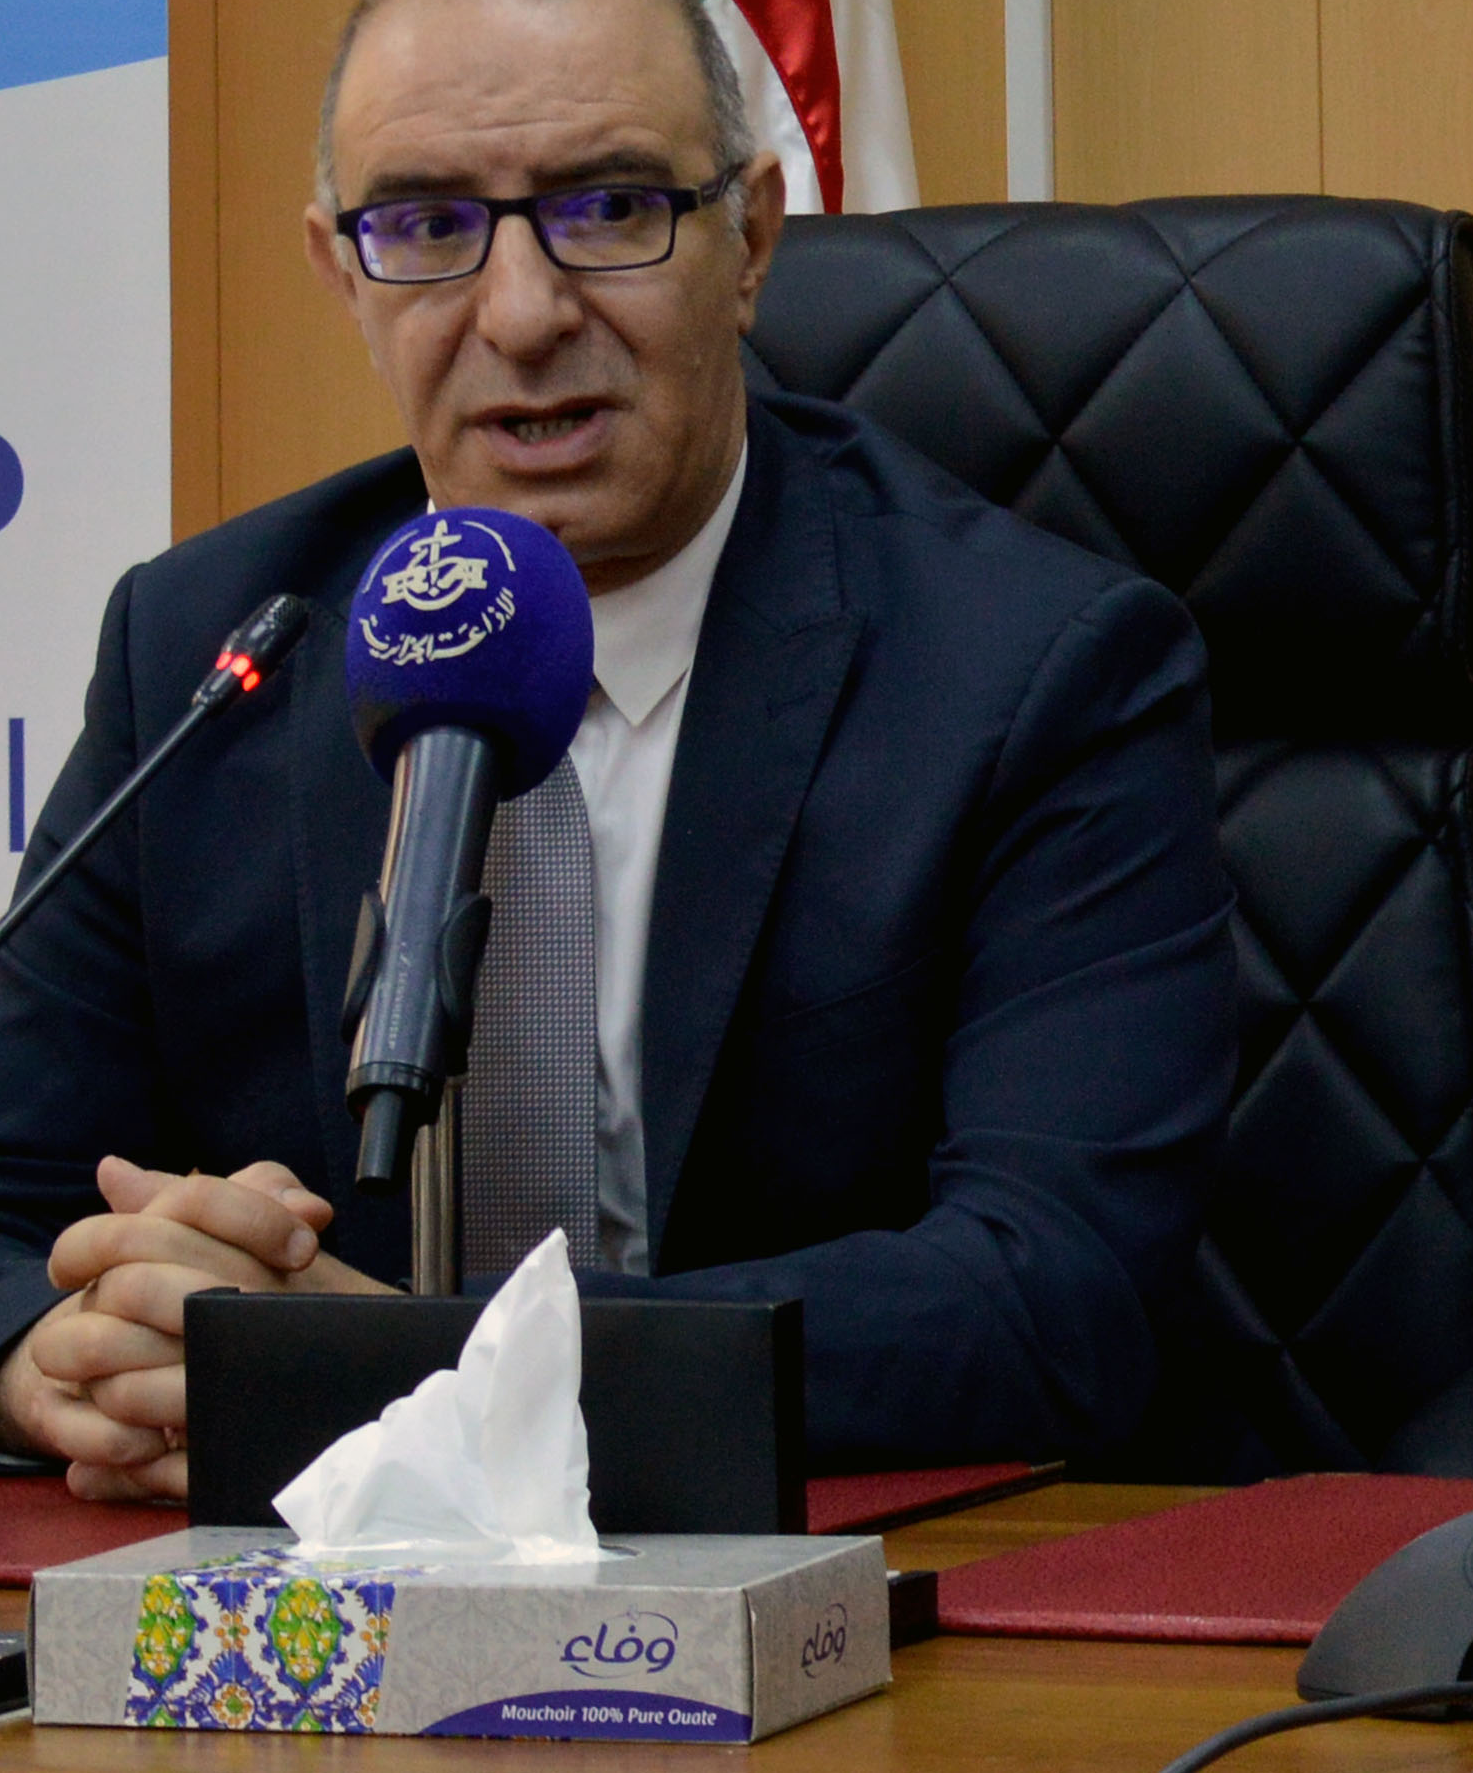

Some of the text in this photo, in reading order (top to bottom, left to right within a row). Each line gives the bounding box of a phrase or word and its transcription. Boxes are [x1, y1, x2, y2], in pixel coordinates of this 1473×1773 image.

[501, 1703, 718, 1727] Mouchoir 100% Pure Ouate
